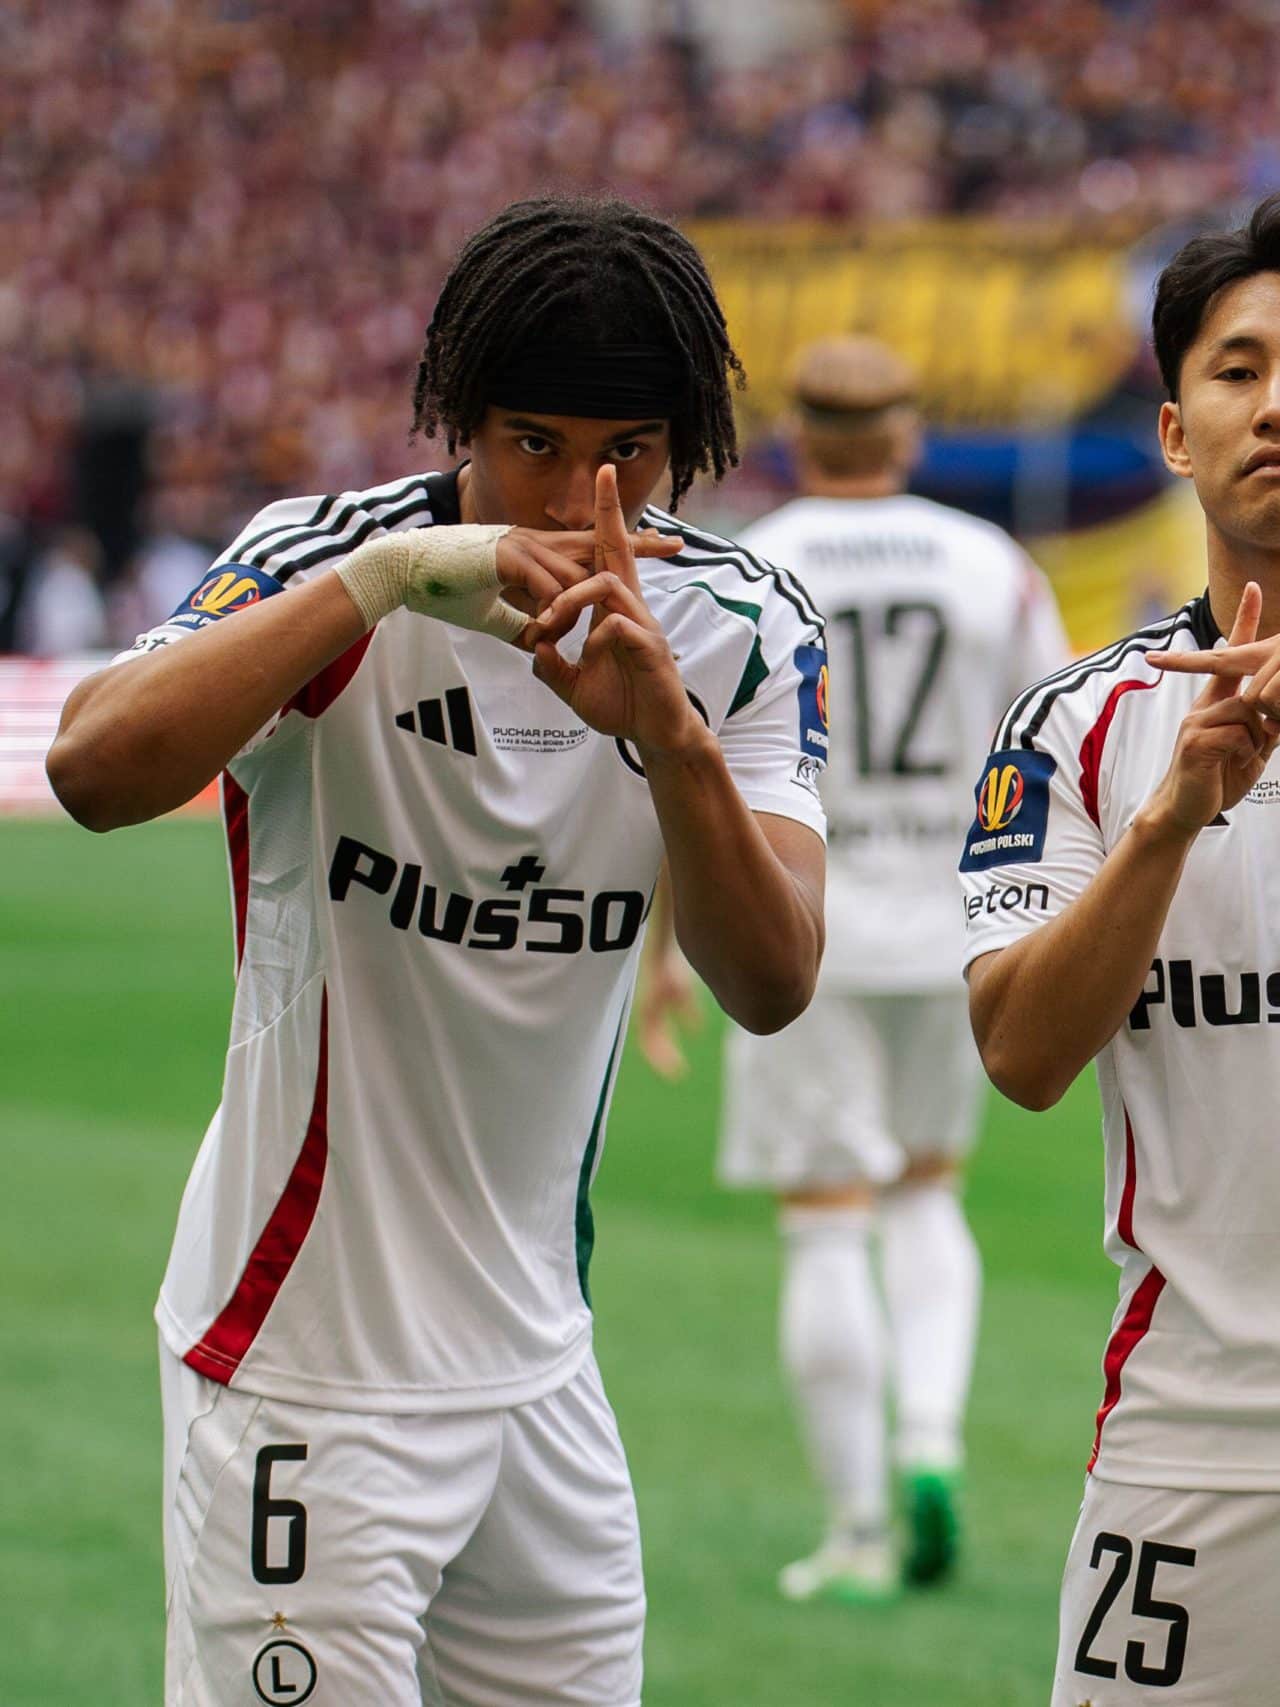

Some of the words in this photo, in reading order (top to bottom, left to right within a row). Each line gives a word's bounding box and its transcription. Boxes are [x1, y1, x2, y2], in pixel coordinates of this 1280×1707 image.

[493, 728, 541, 737] PUCHAR
[543, 726, 589, 738] POLSKI
[833, 602, 949, 776] 12
[328, 835, 657, 954] Plus50
[997, 833, 1034, 849] POLSKI
[251, 1444, 308, 1585] 6
[1074, 1531, 1197, 1687] 25
[271, 1656, 297, 1693] L
